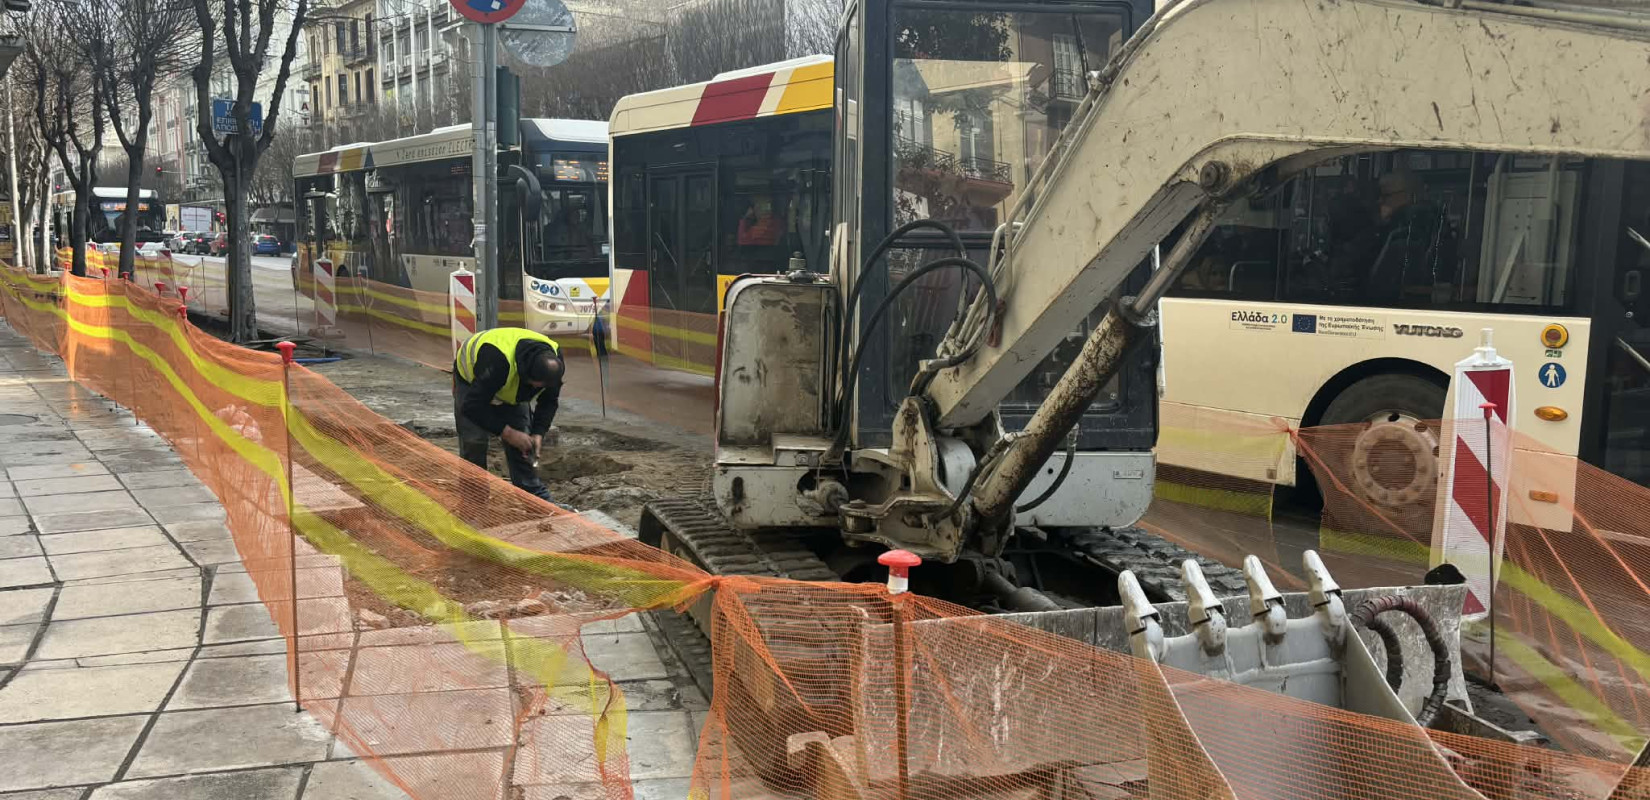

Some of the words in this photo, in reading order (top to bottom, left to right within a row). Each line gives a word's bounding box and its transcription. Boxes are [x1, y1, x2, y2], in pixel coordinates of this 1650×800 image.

[1231, 311, 1269, 323] Ελλάδα
[1271, 314, 1288, 324] 2.0
[1393, 323, 1464, 339] YUTONG
